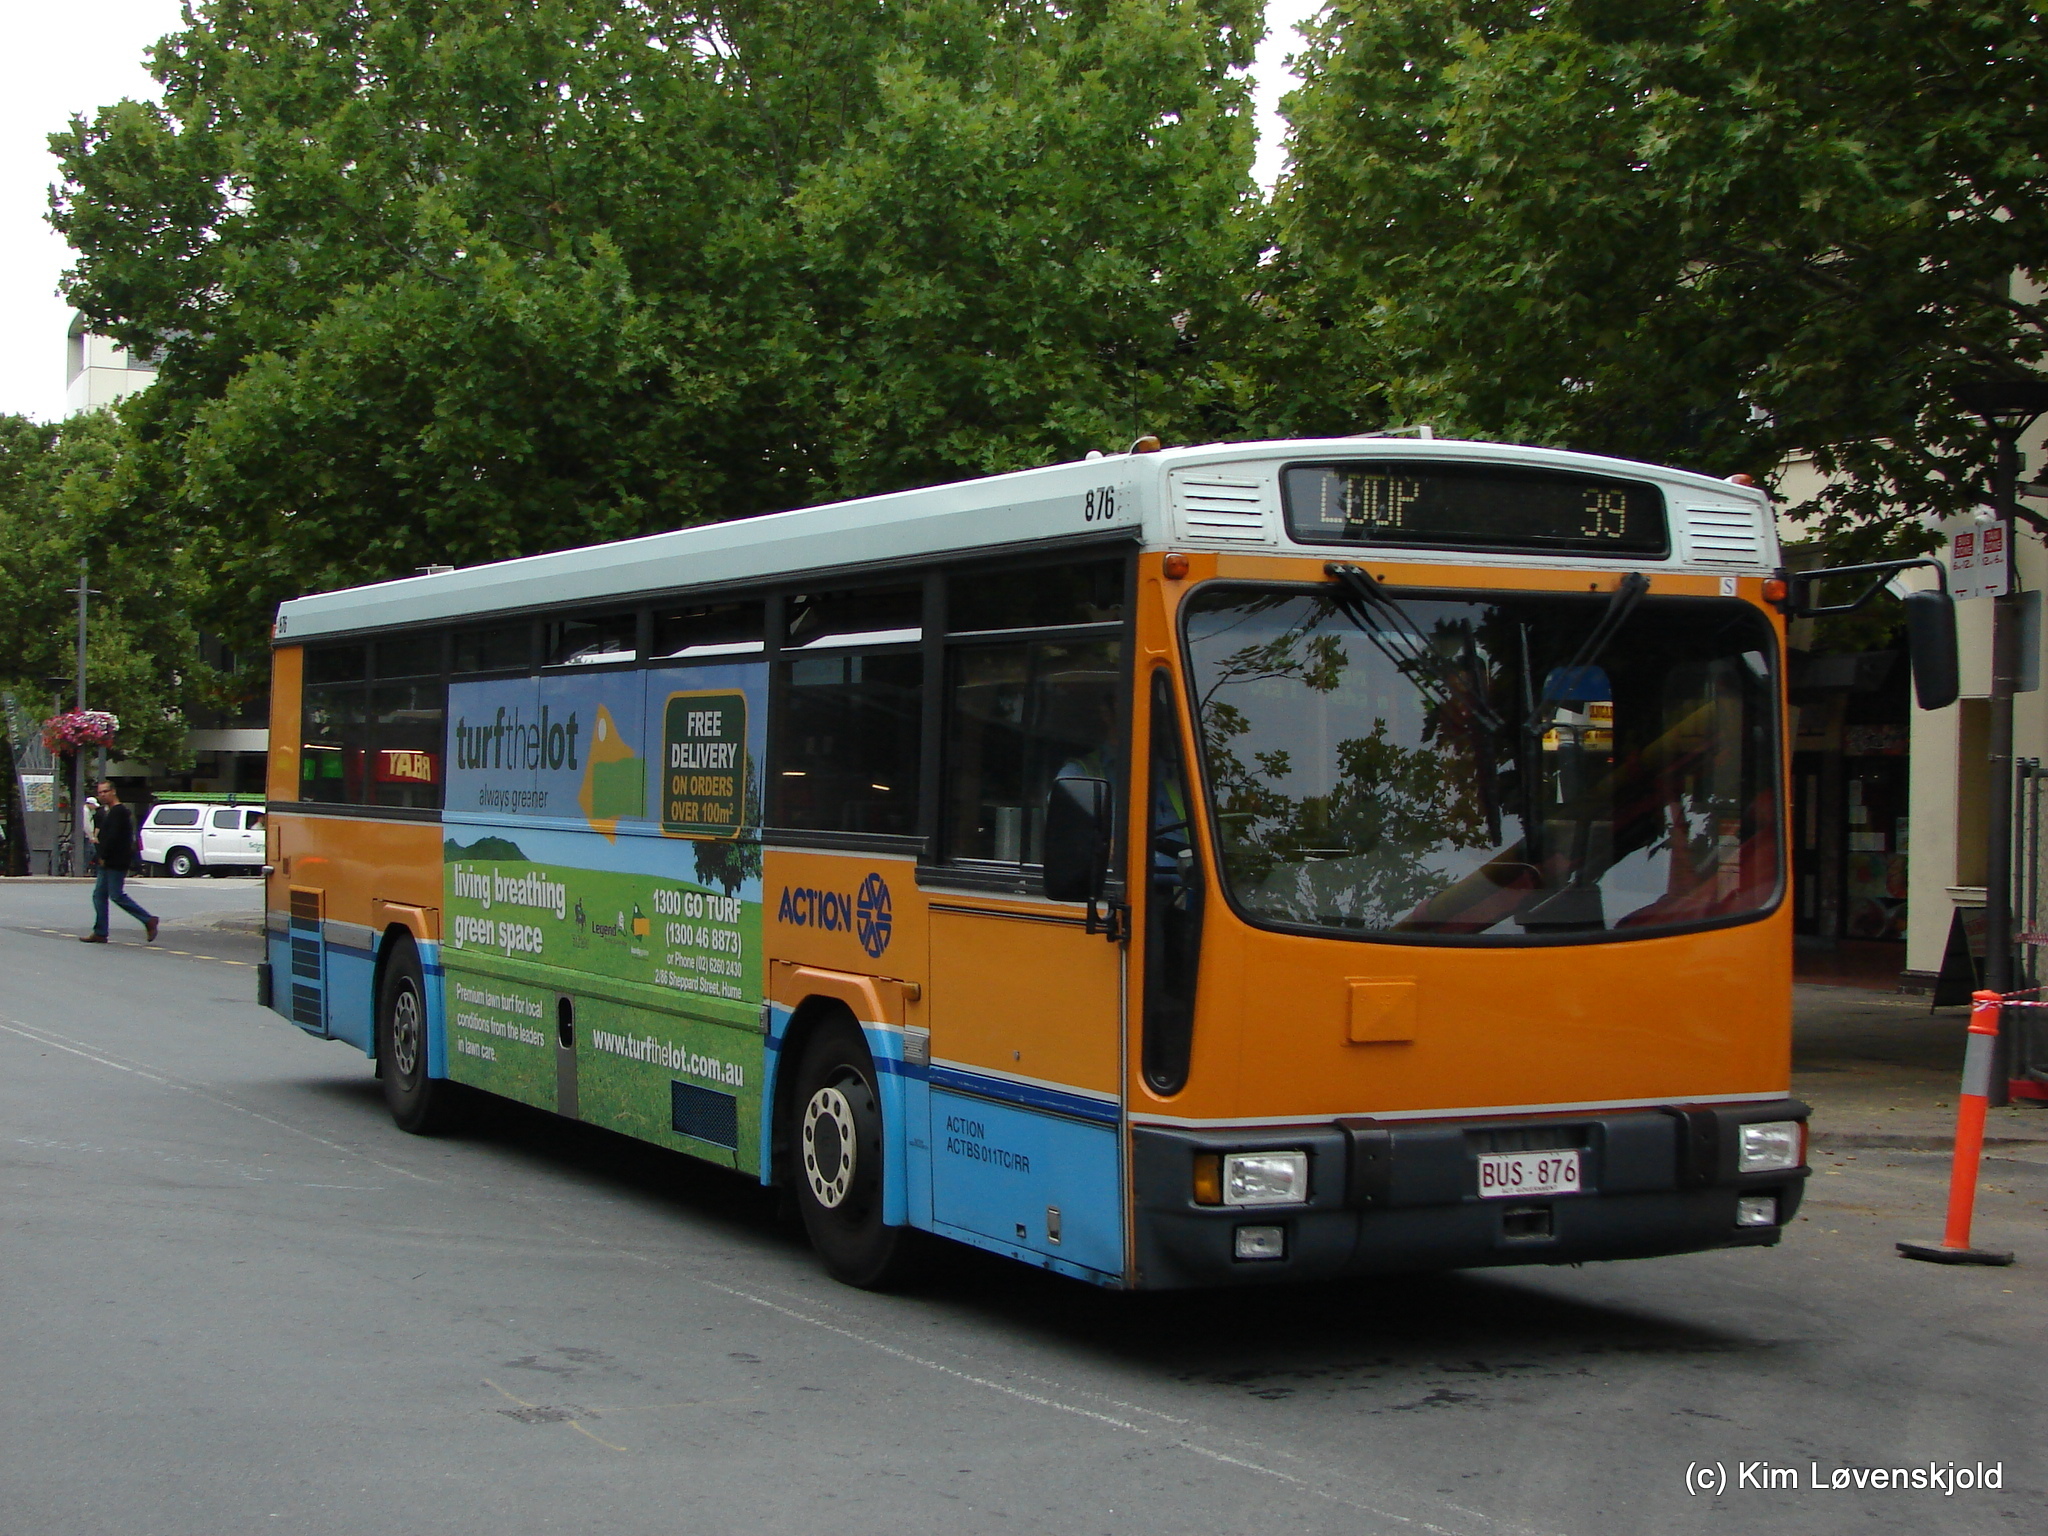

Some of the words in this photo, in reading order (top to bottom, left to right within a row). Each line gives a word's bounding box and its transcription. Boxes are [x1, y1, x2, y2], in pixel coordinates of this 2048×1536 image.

[1085, 485, 1115, 522] 876
[1580, 488, 1626, 538] 39
[1722, 578, 1734, 595] S
[687, 711, 722, 737] FREE
[671, 743, 738, 769] DELIVERY
[479, 783, 510, 811] always
[511, 789, 549, 813] greener
[672, 775, 688, 795] ON
[690, 776, 734, 797] ORDERS
[671, 801, 699, 822] OVER
[454, 863, 491, 909] living
[494, 867, 566, 920] breathing
[653, 889, 681, 916] 1300
[684, 892, 703, 919] GO
[706, 895, 742, 923] TURF
[778, 885, 852, 933] ACTION
[455, 915, 495, 949] green
[499, 921, 543, 957] space
[591, 921, 617, 938] Legend
[666, 922, 694, 948] (1300
[696, 926, 709, 949] 46
[711, 928, 742, 960] 8873)
[666, 953, 675, 965] or
[674, 951, 695, 969] Phone
[696, 955, 708, 975] (02)
[709, 958, 725, 974] 6260
[726, 961, 742, 978] 2430
[456, 982, 485, 1005] Premium
[485, 988, 500, 1009] lawn
[501, 993, 514, 1012] turf
[515, 995, 525, 1014] for
[525, 997, 543, 1018] local
[669, 970, 699, 992] Sheppard
[722, 980, 742, 1000] Hume
[457, 1012, 490, 1033] conditions
[490, 1016, 507, 1037] from
[507, 1021, 519, 1040] the
[519, 1023, 545, 1047] leaders
[457, 1034, 465, 1053] in
[465, 1036, 480, 1057] lawn
[481, 1045, 497, 1061] care.
[593, 1029, 744, 1087] www.turfthelot.com.au
[946, 1115, 985, 1140] ACTION
